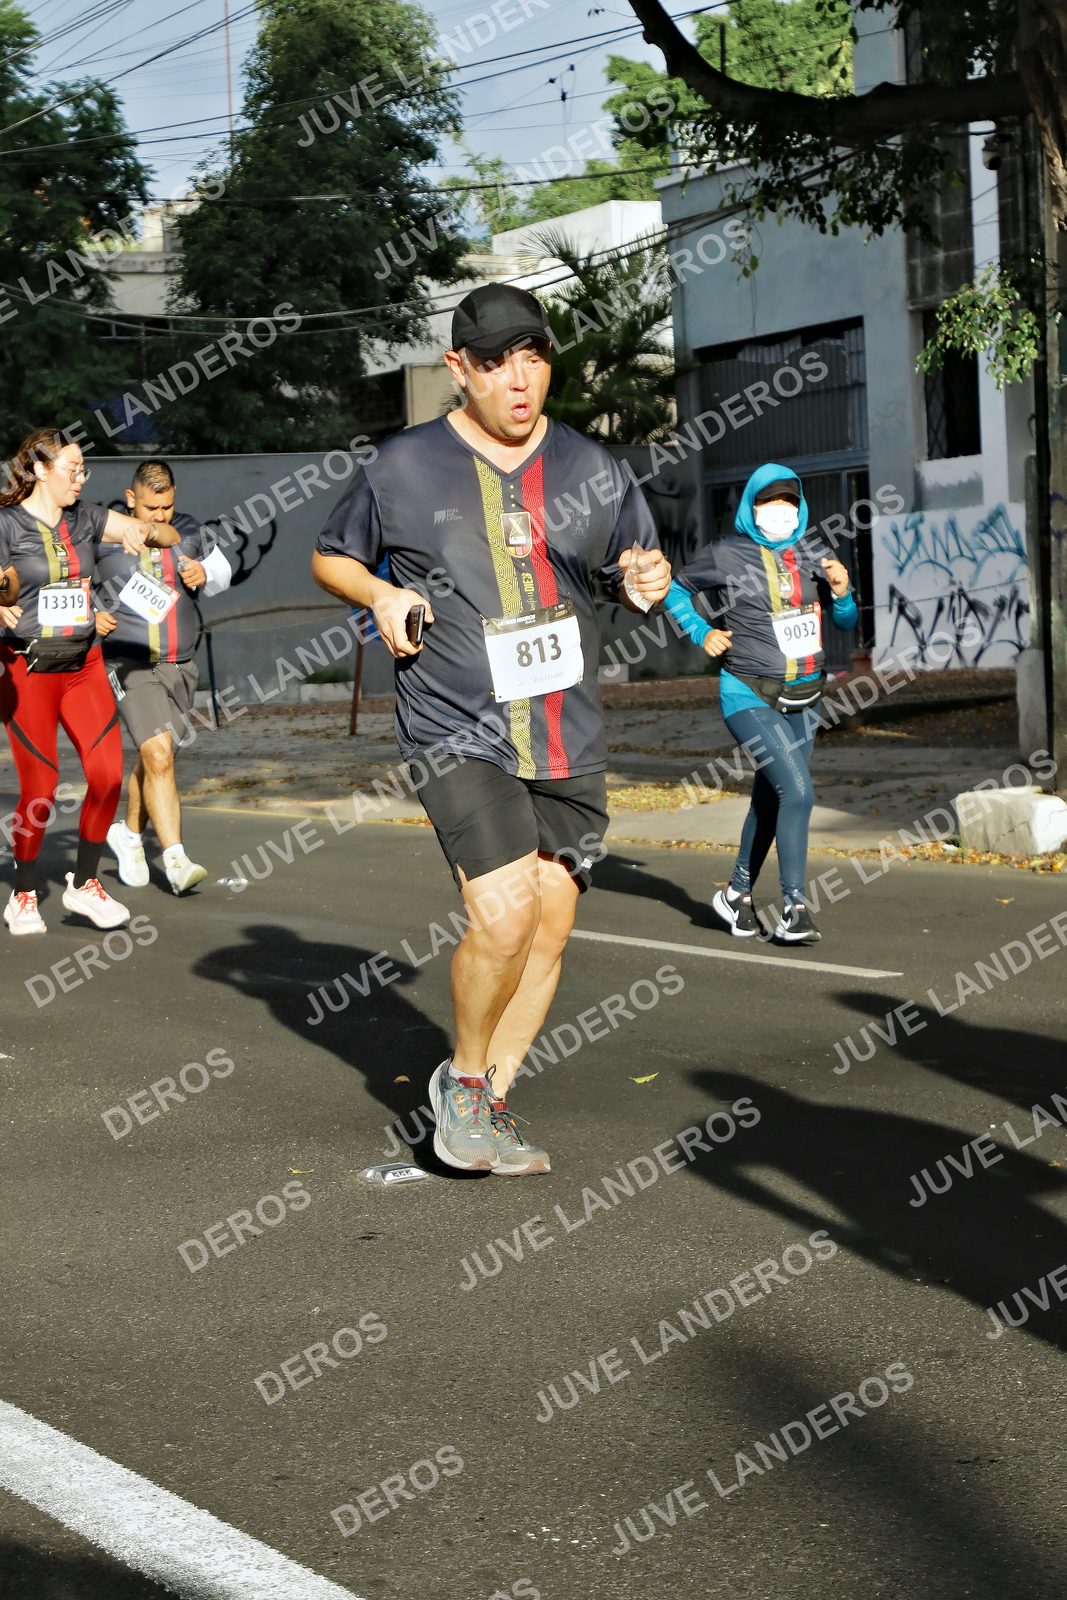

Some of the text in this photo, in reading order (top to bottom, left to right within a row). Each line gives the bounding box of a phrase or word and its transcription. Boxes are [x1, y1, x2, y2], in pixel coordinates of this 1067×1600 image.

[42, 594, 84, 611] 13319
[131, 579, 167, 610] 10260
[783, 620, 817, 642] 9032
[516, 633, 562, 668] 813
